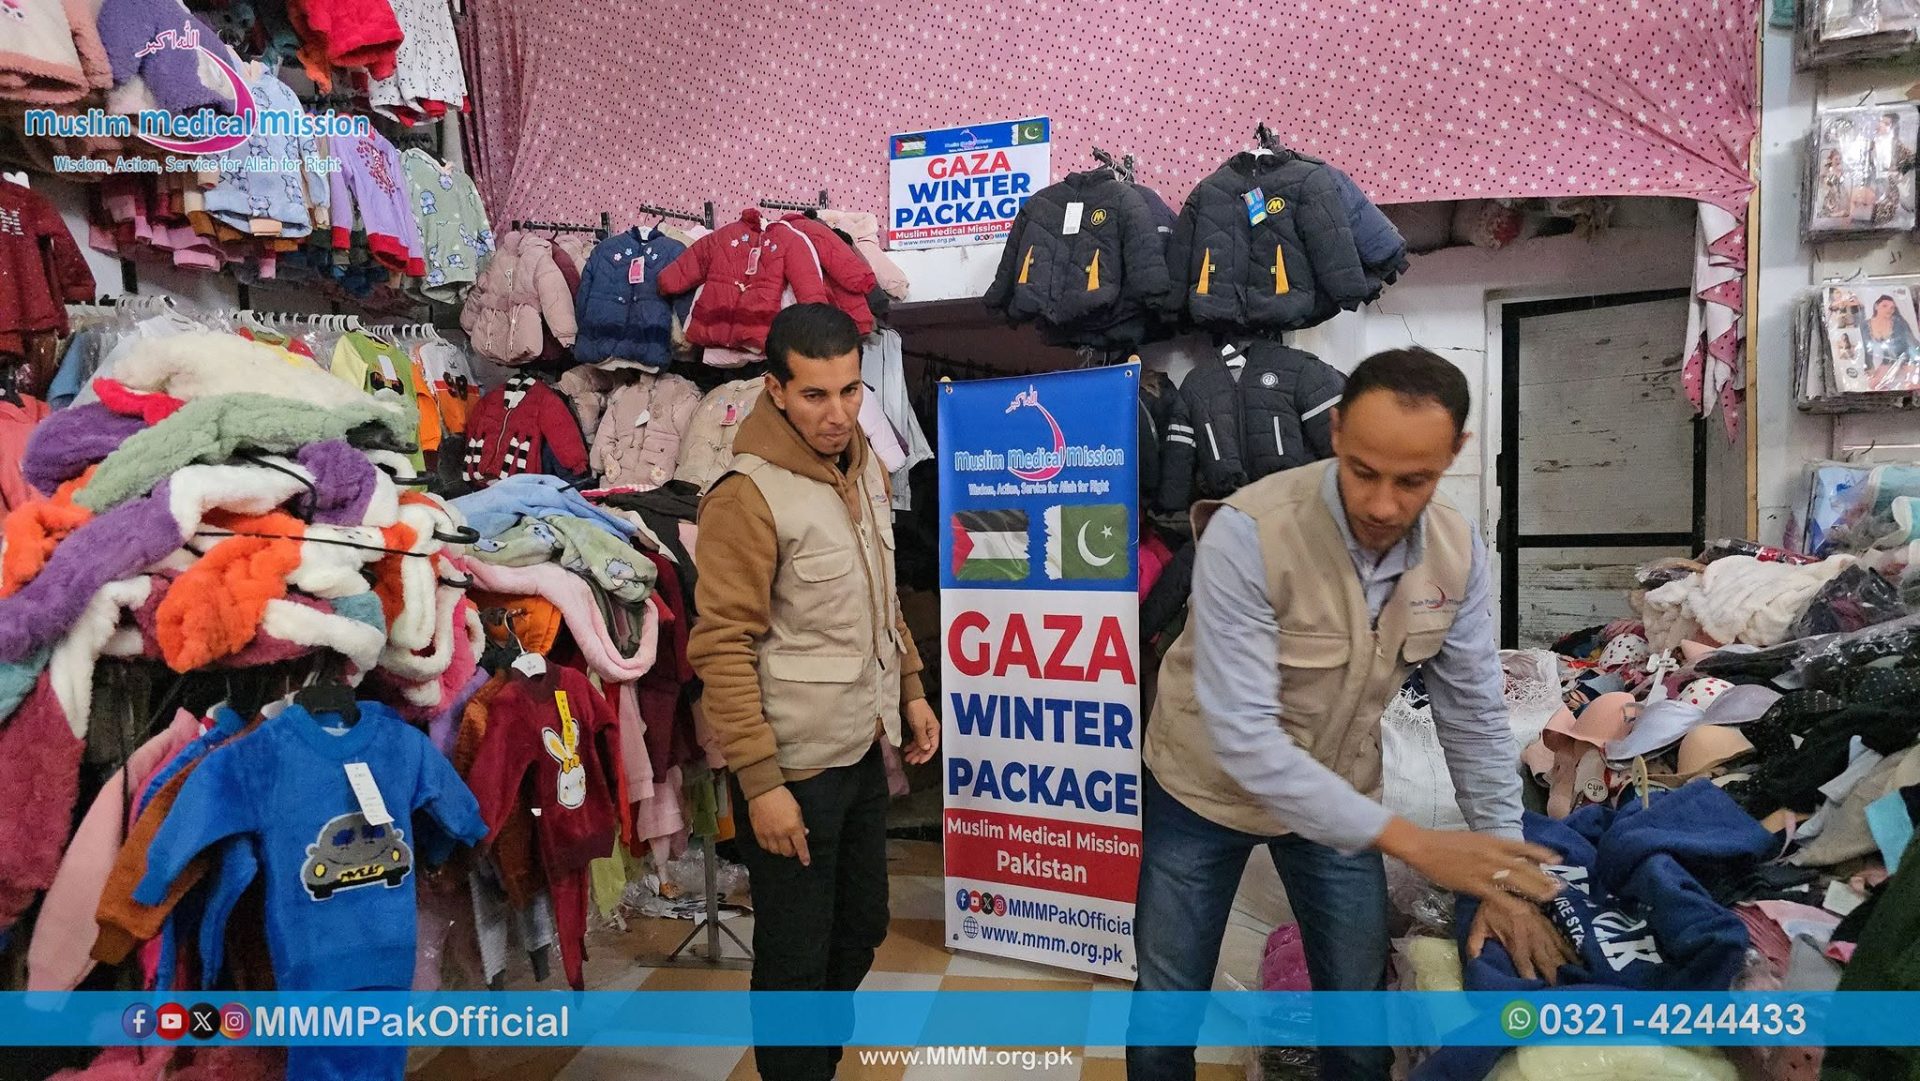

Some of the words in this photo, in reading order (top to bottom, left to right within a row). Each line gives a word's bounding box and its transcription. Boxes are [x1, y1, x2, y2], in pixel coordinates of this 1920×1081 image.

[927, 151, 1012, 179] GAZA
[908, 172, 1031, 204] WINTER
[895, 230, 928, 240] Muslim
[930, 226, 965, 237] Medical
[968, 223, 1002, 233] Mission
[947, 610, 1137, 685] GAZA
[950, 692, 1133, 750] WINTER
[948, 757, 1138, 816] PACKAGE
[947, 817, 1004, 839] Muslim
[1008, 824, 1071, 849] Medical
[1076, 832, 1140, 858] Mission
[997, 850, 1088, 884] Pakistan
[981, 925, 1123, 965] www.mmm.org.pk
